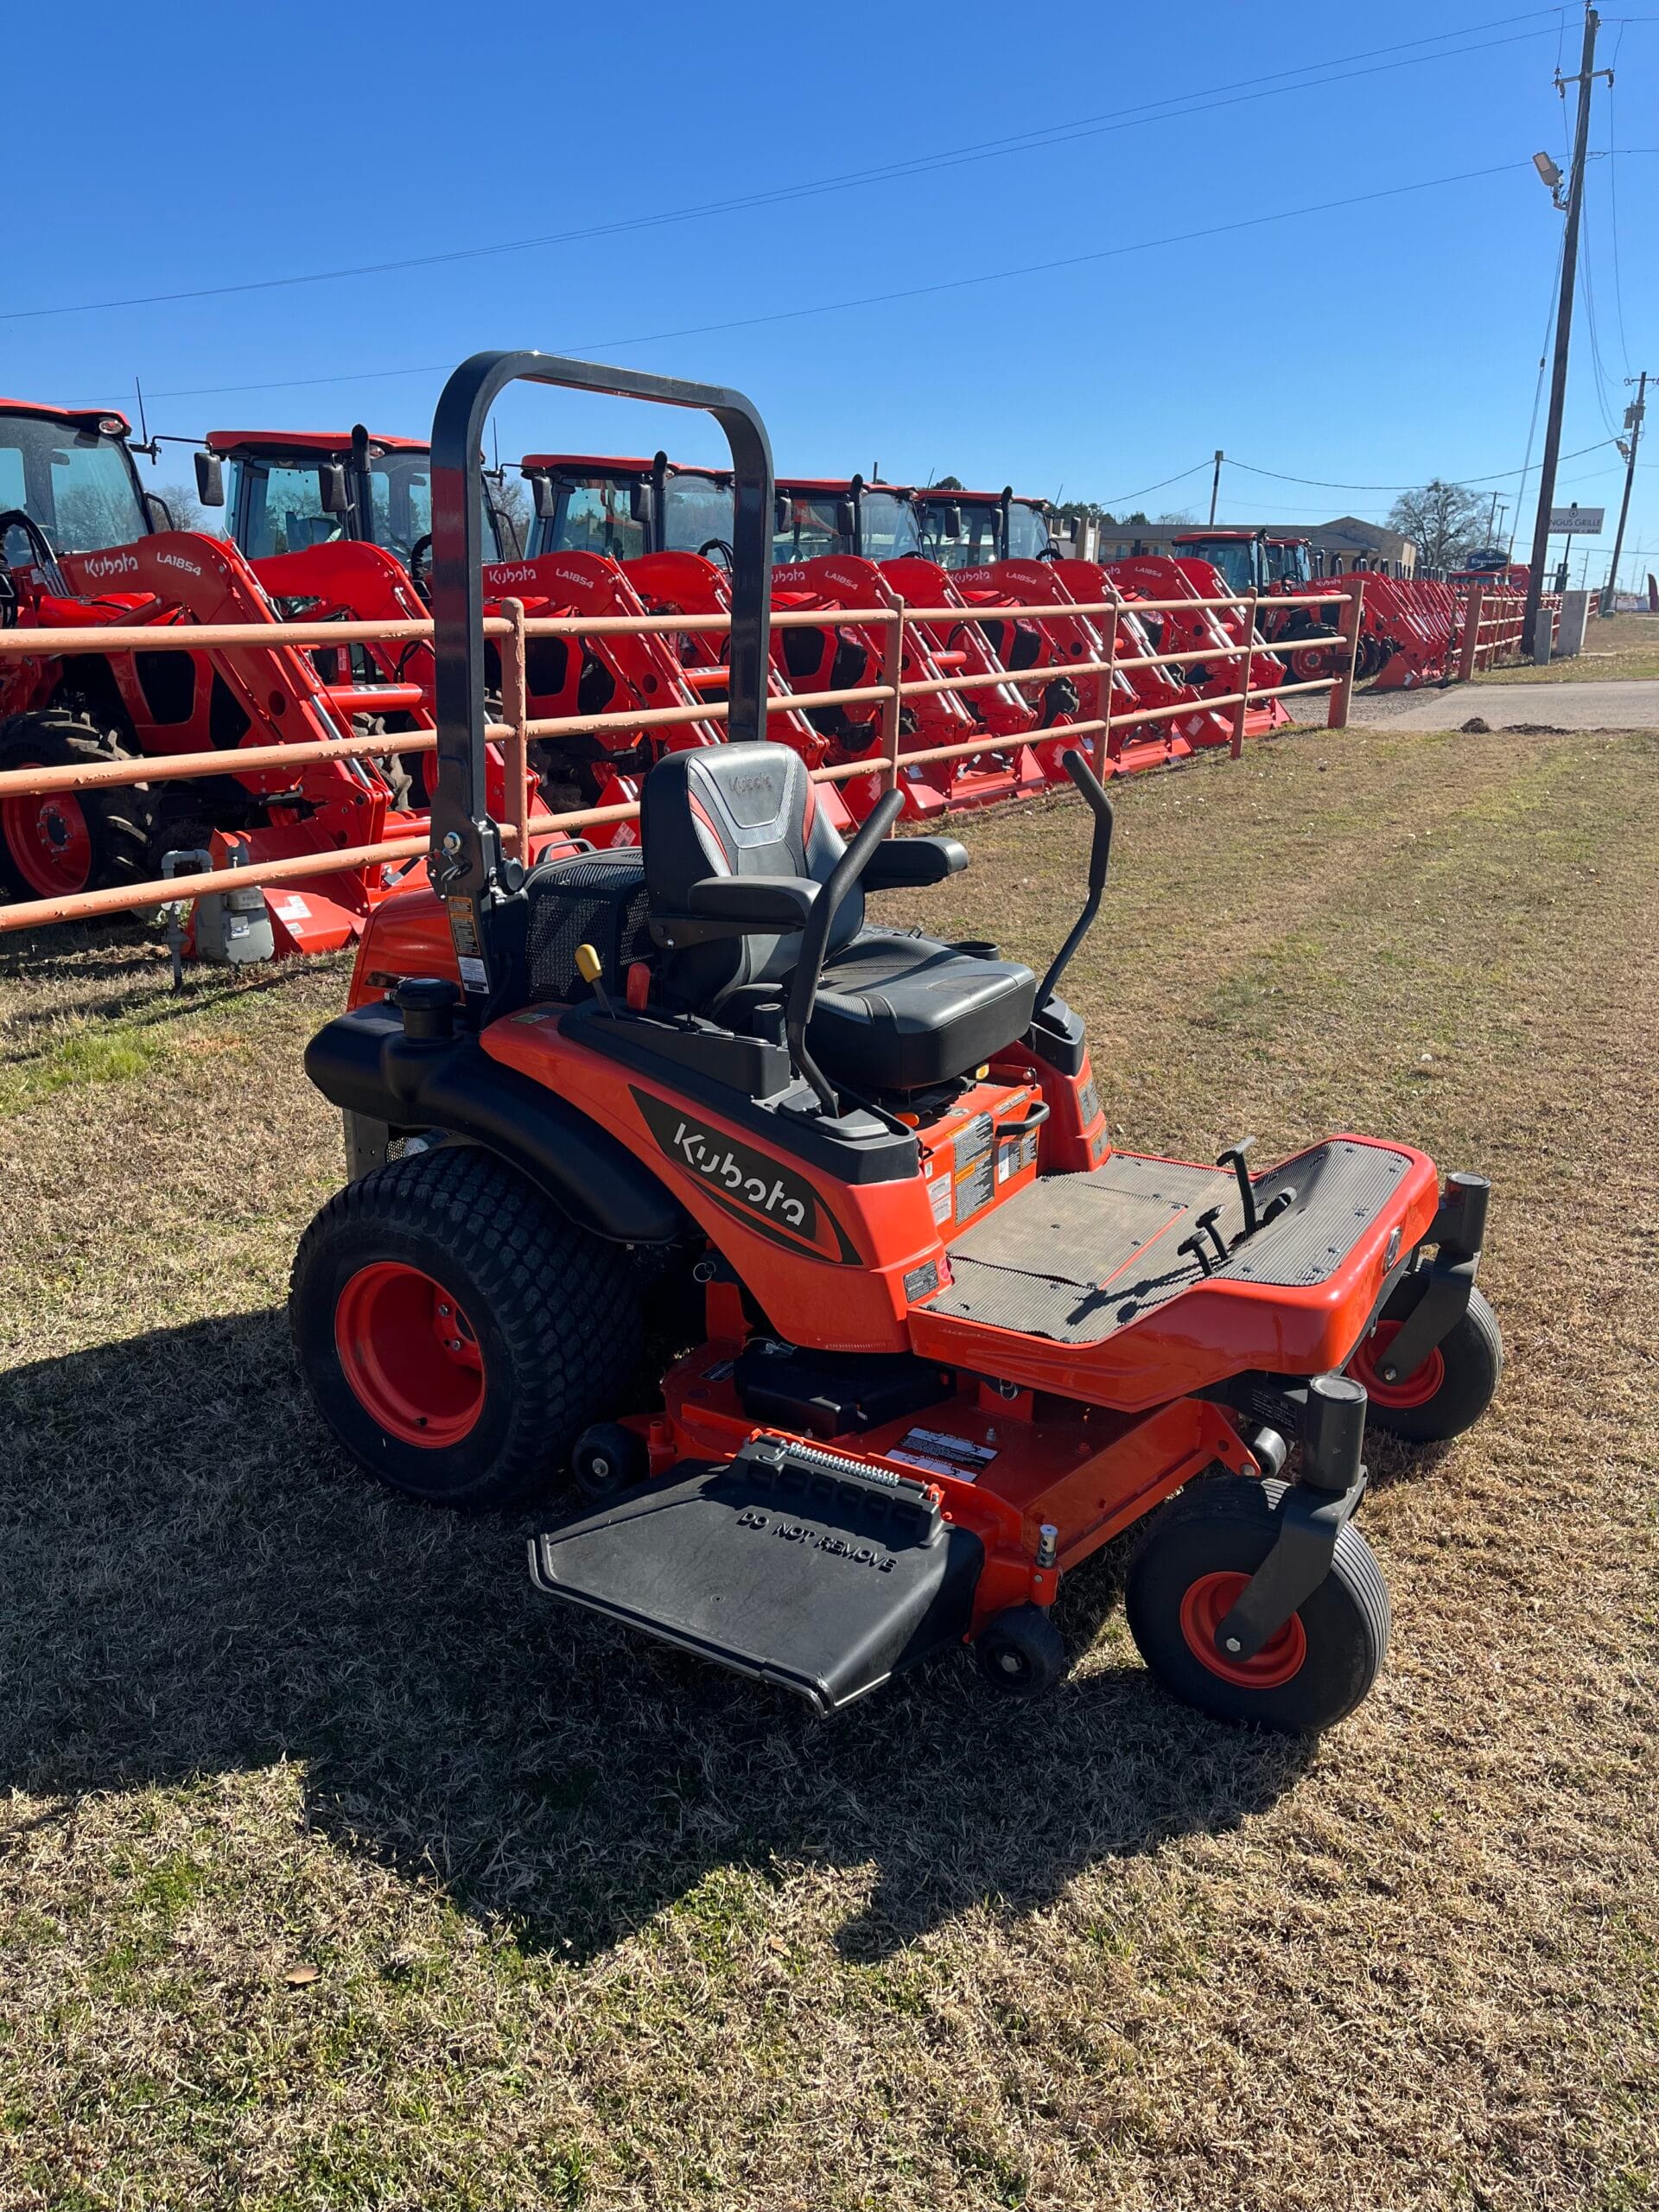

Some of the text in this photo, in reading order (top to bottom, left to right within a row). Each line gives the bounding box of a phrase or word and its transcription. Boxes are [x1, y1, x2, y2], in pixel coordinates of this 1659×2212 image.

[1550, 518, 1601, 527] NGUS GRILLE
[84, 551, 202, 578] Kubota LA1854
[489, 565, 594, 588] Kubota LA1854
[771, 569, 859, 590] ubota LA1854
[950, 569, 1037, 585] Kubota LA1854
[1316, 578, 1342, 588] Kubota
[673, 1122, 805, 1226] Kubota
[736, 1512, 898, 1573] DO NOT REMOVE
